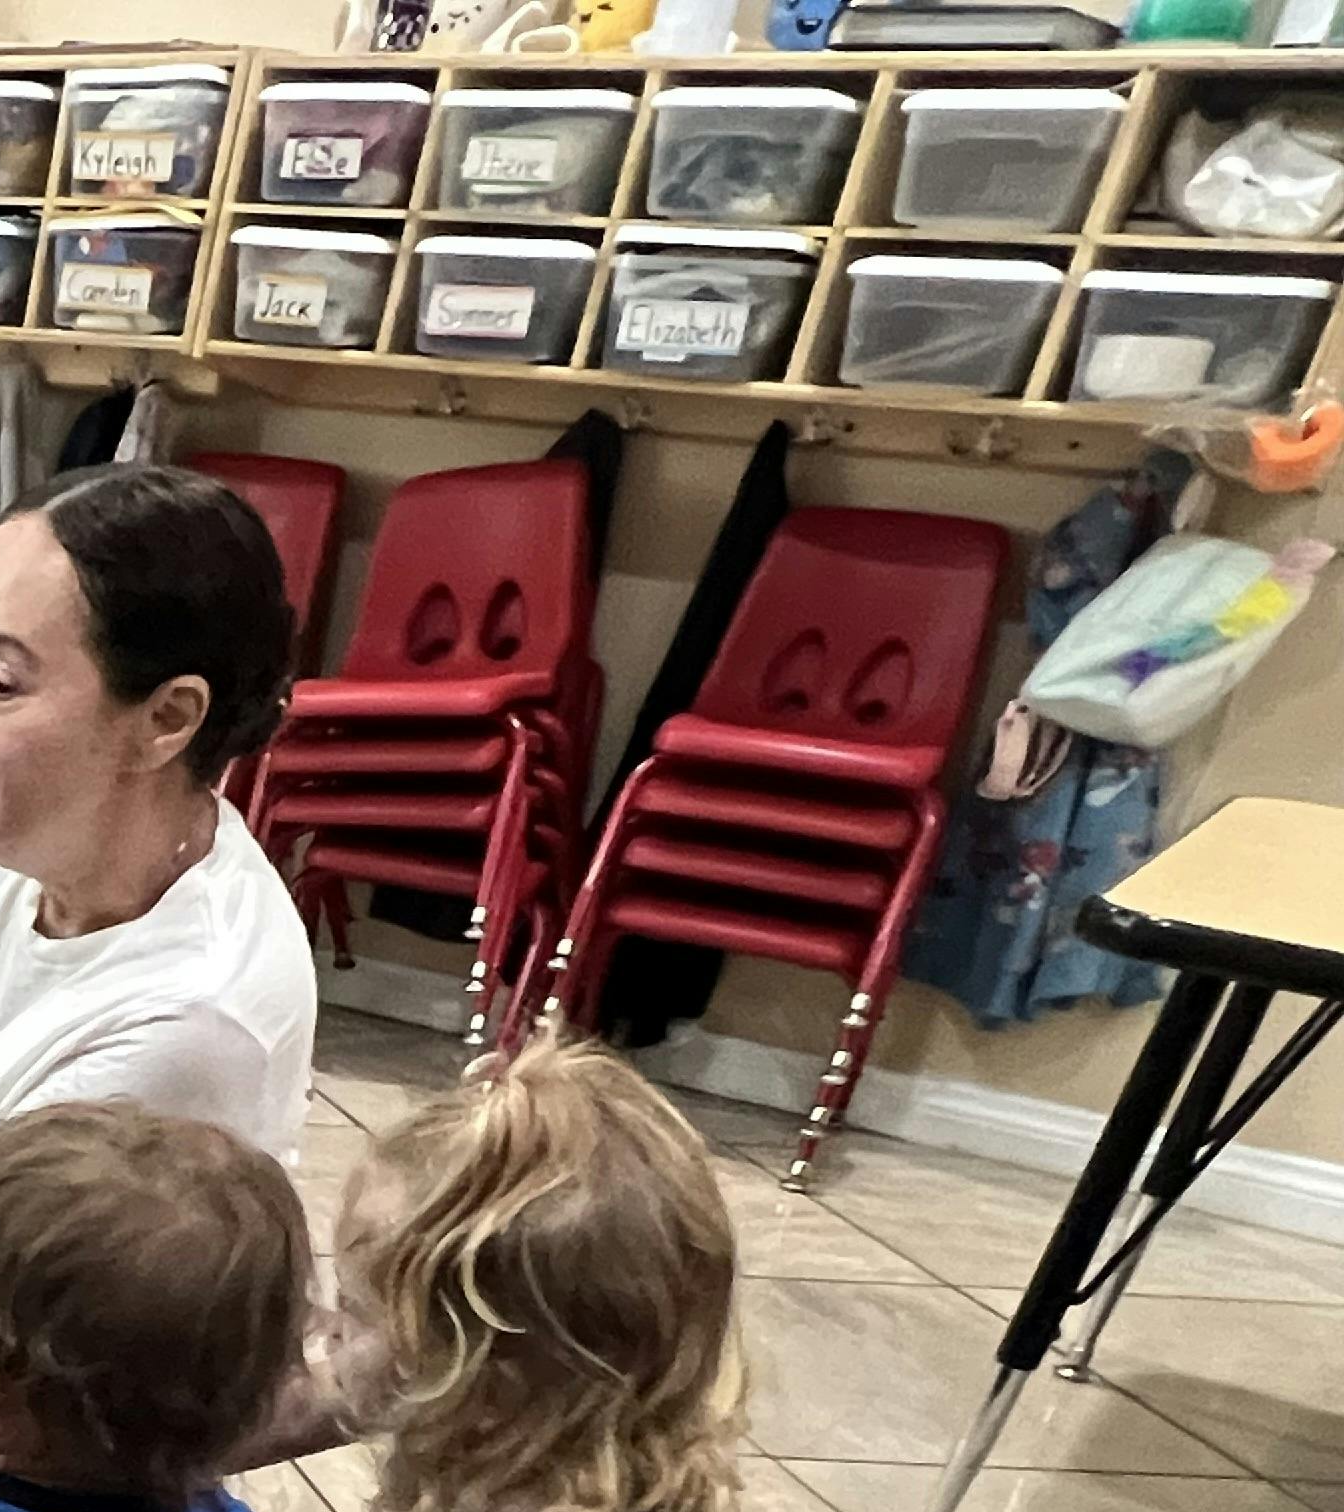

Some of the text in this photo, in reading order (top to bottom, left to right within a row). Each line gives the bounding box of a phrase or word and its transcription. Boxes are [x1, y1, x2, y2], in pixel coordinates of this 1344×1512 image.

[80, 139, 157, 177] Kyleigh
[260, 284, 312, 319] Jack
[627, 304, 738, 346] Elizabeth
